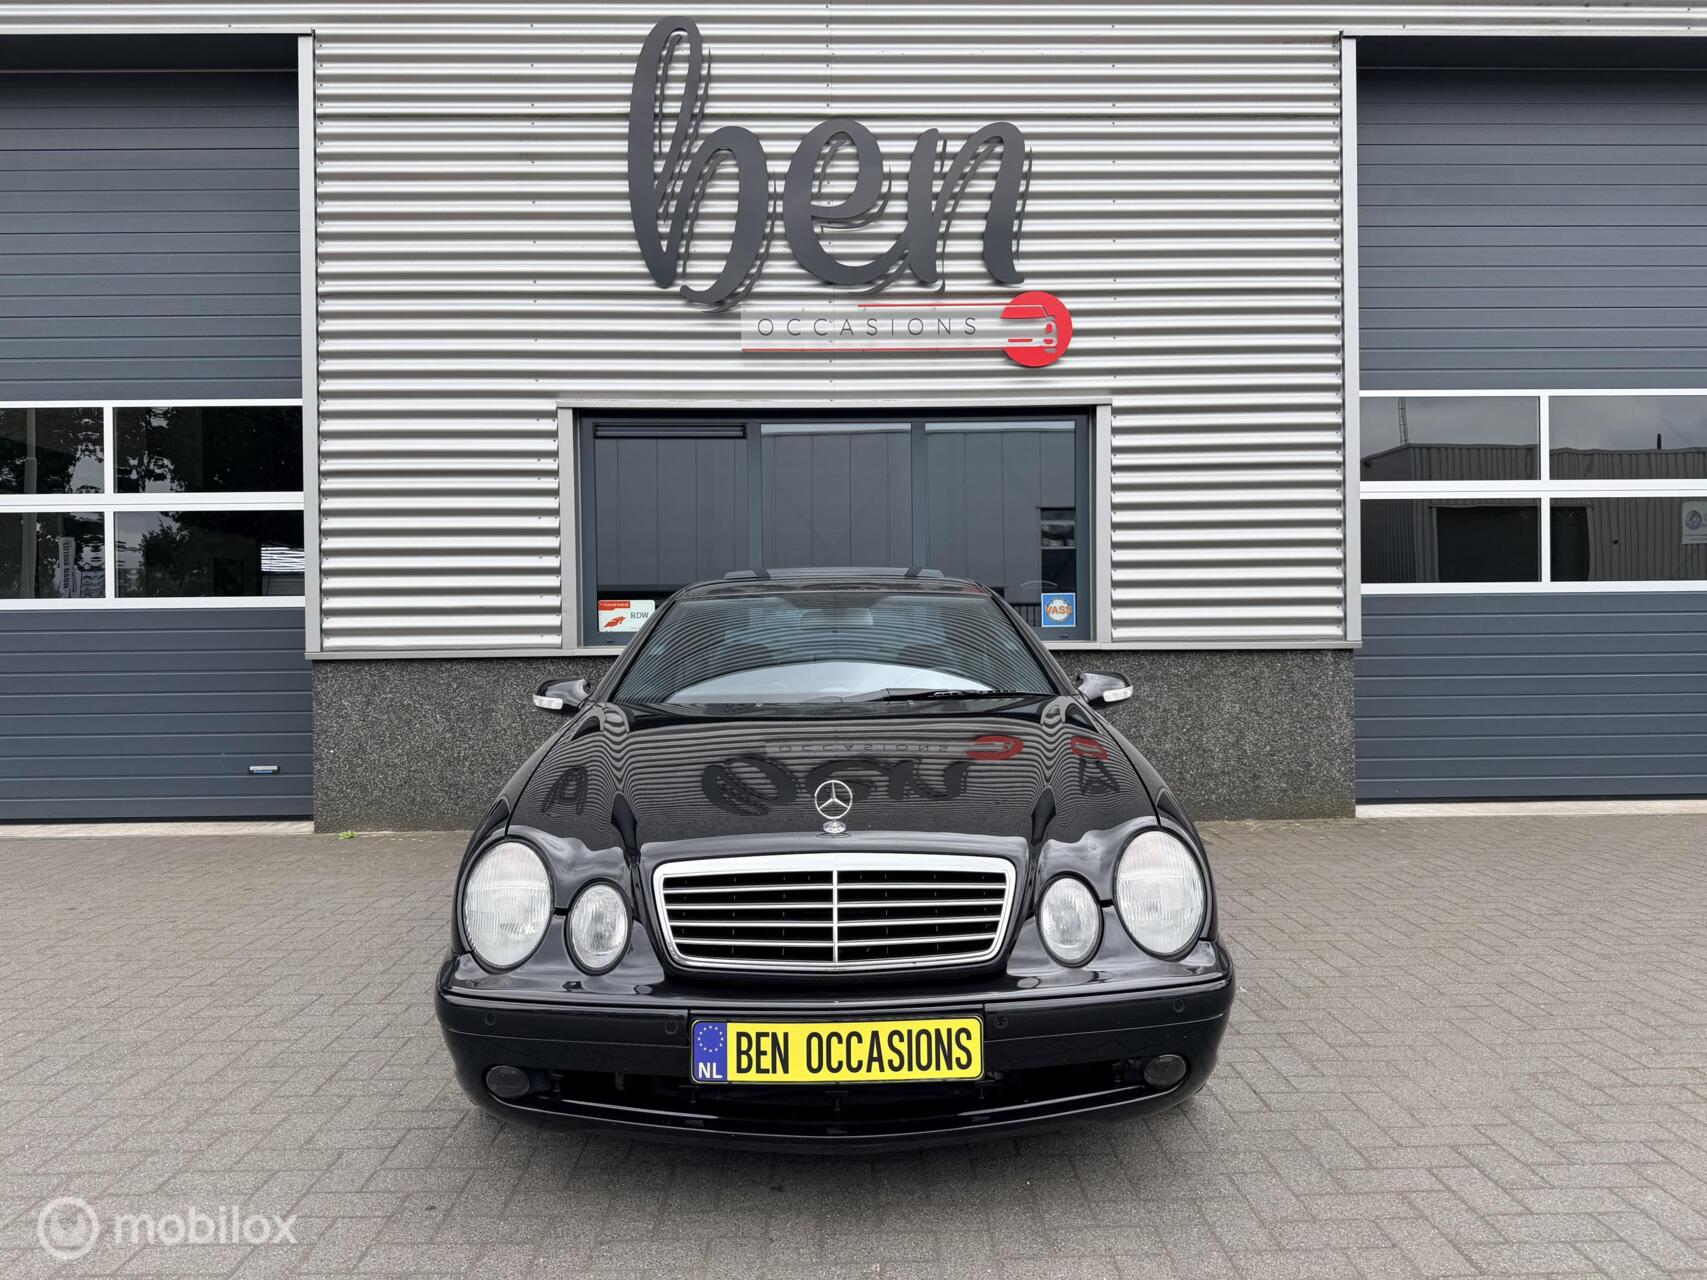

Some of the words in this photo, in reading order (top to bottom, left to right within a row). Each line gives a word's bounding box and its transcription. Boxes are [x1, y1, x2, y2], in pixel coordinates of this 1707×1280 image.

[628, 16, 1026, 305] ben
[757, 316, 977, 337] OCCASIONS
[630, 611, 649, 619] RDW
[735, 1032, 789, 1074] BEN
[806, 1027, 973, 1073] OCCASIONS
[698, 1062, 723, 1078] NL
